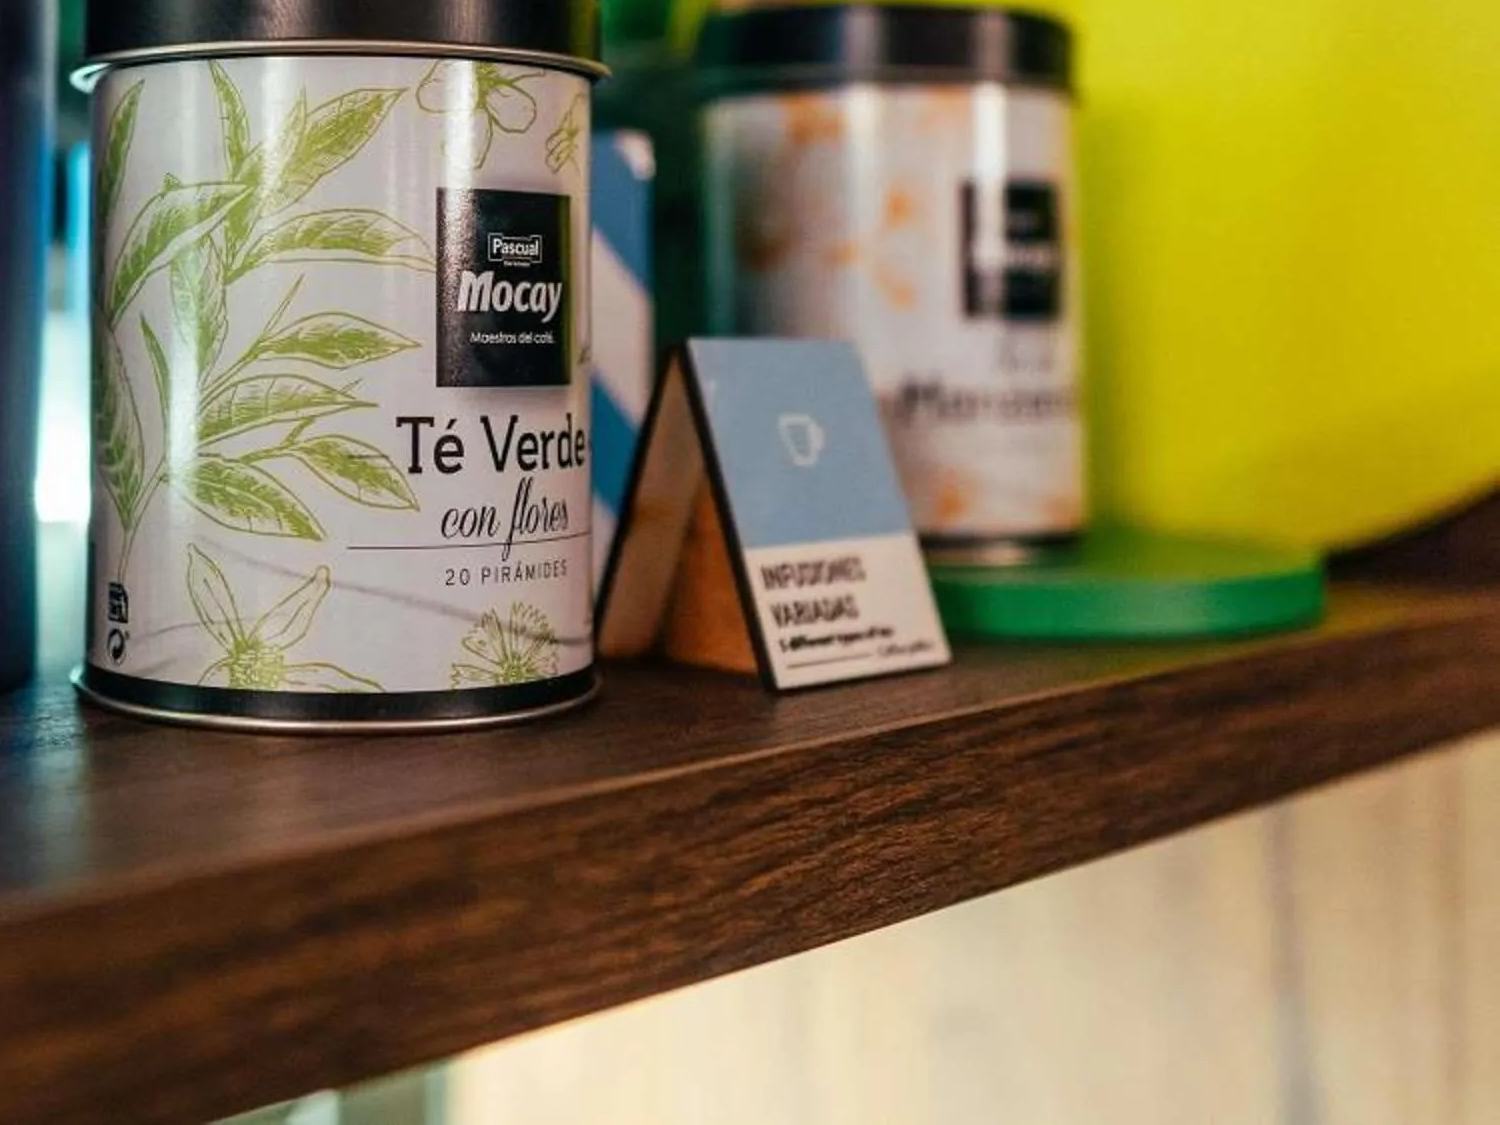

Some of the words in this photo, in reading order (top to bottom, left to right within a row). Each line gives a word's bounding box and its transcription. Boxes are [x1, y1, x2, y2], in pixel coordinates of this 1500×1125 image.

[491, 237, 539, 257] Pascual
[457, 270, 563, 324] Mocay
[469, 331, 517, 344] Maestros
[396, 416, 465, 475] Té
[479, 412, 586, 473] Verde
[440, 505, 501, 539] con
[501, 476, 569, 562] flores
[445, 568, 471, 586] 20
[481, 559, 568, 584] PIRÁMIDES
[760, 555, 867, 591] INFUSIONES
[769, 595, 860, 628] VARIADAS
